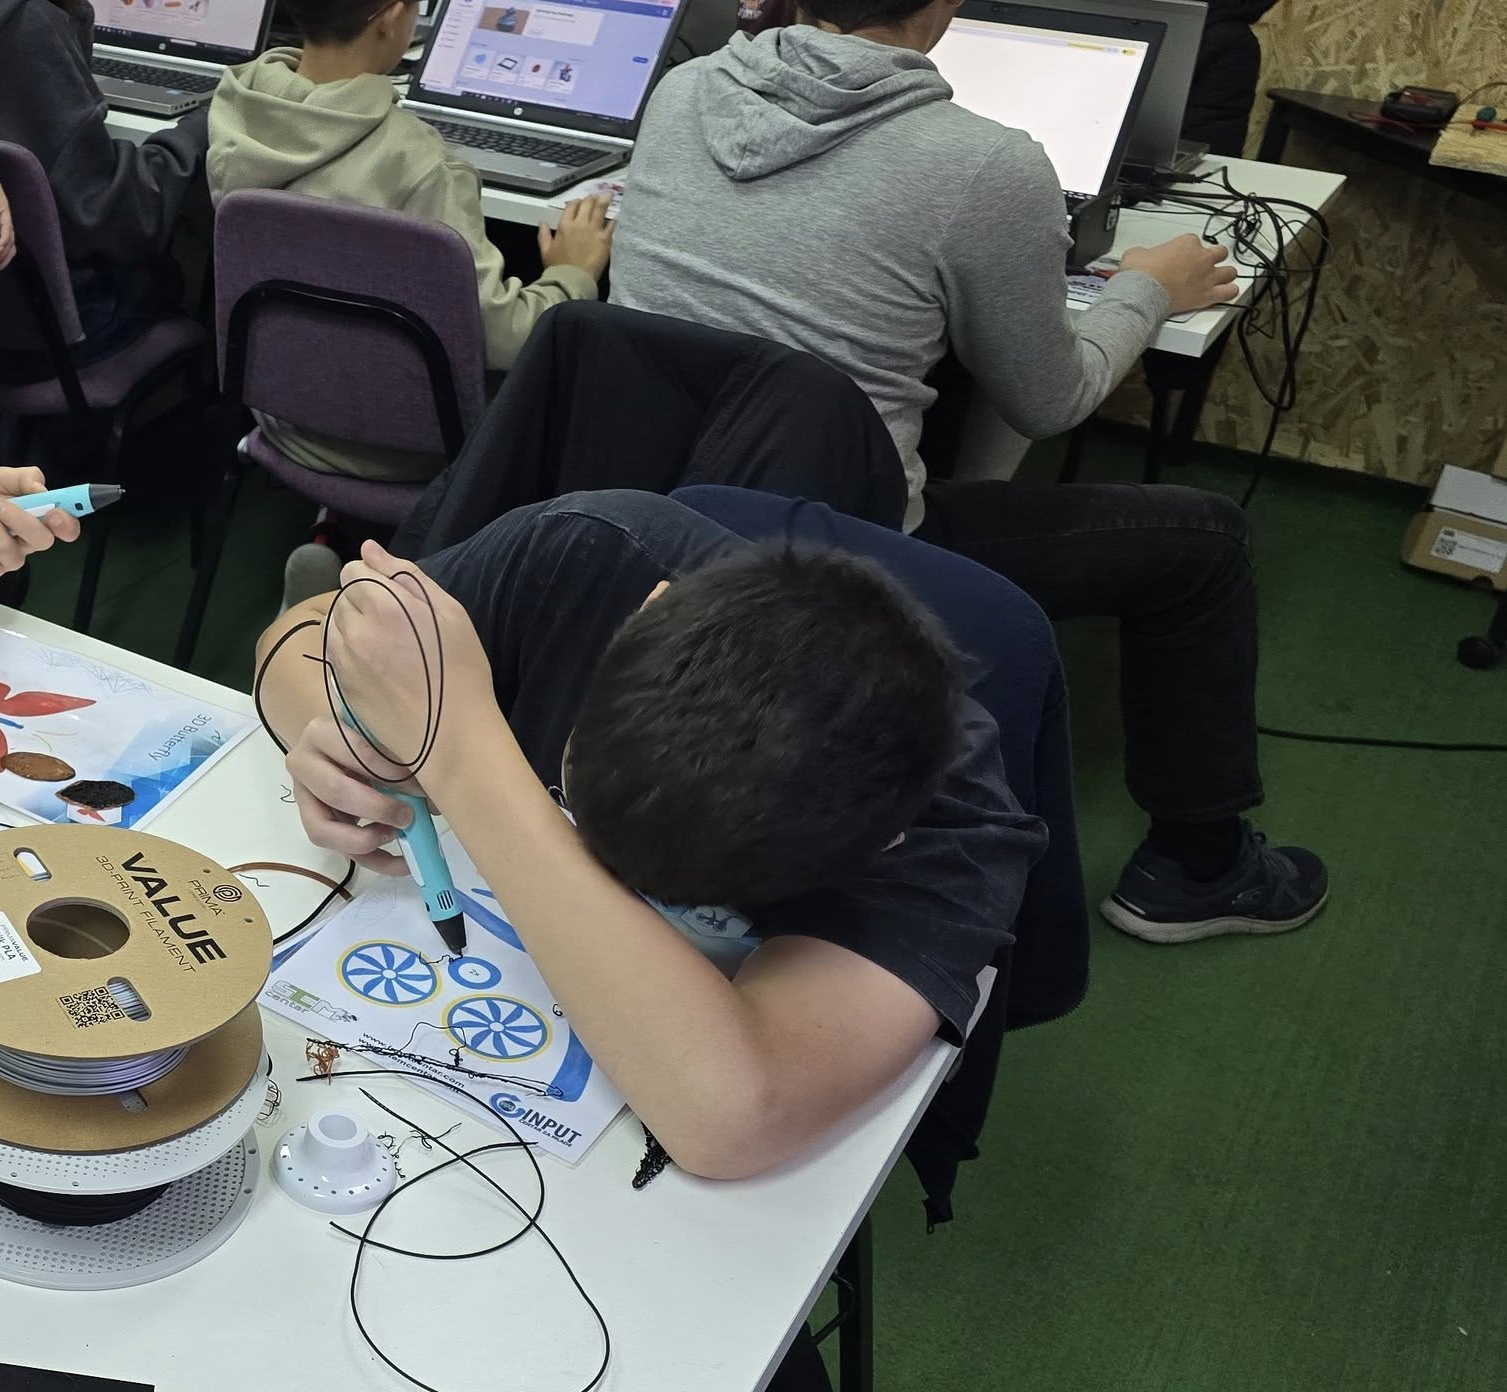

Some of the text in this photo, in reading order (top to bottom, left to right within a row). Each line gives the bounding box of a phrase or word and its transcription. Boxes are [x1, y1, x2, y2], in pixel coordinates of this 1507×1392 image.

[148, 713, 212, 761] 3D Butterfly
[95, 855, 196, 972] 3D-PRINT FILAMENT
[121, 851, 227, 965] VALUE
[1, 944, 16, 960] PLA
[265, 991, 309, 1013] centar
[522, 1109, 582, 1142] INPUT
